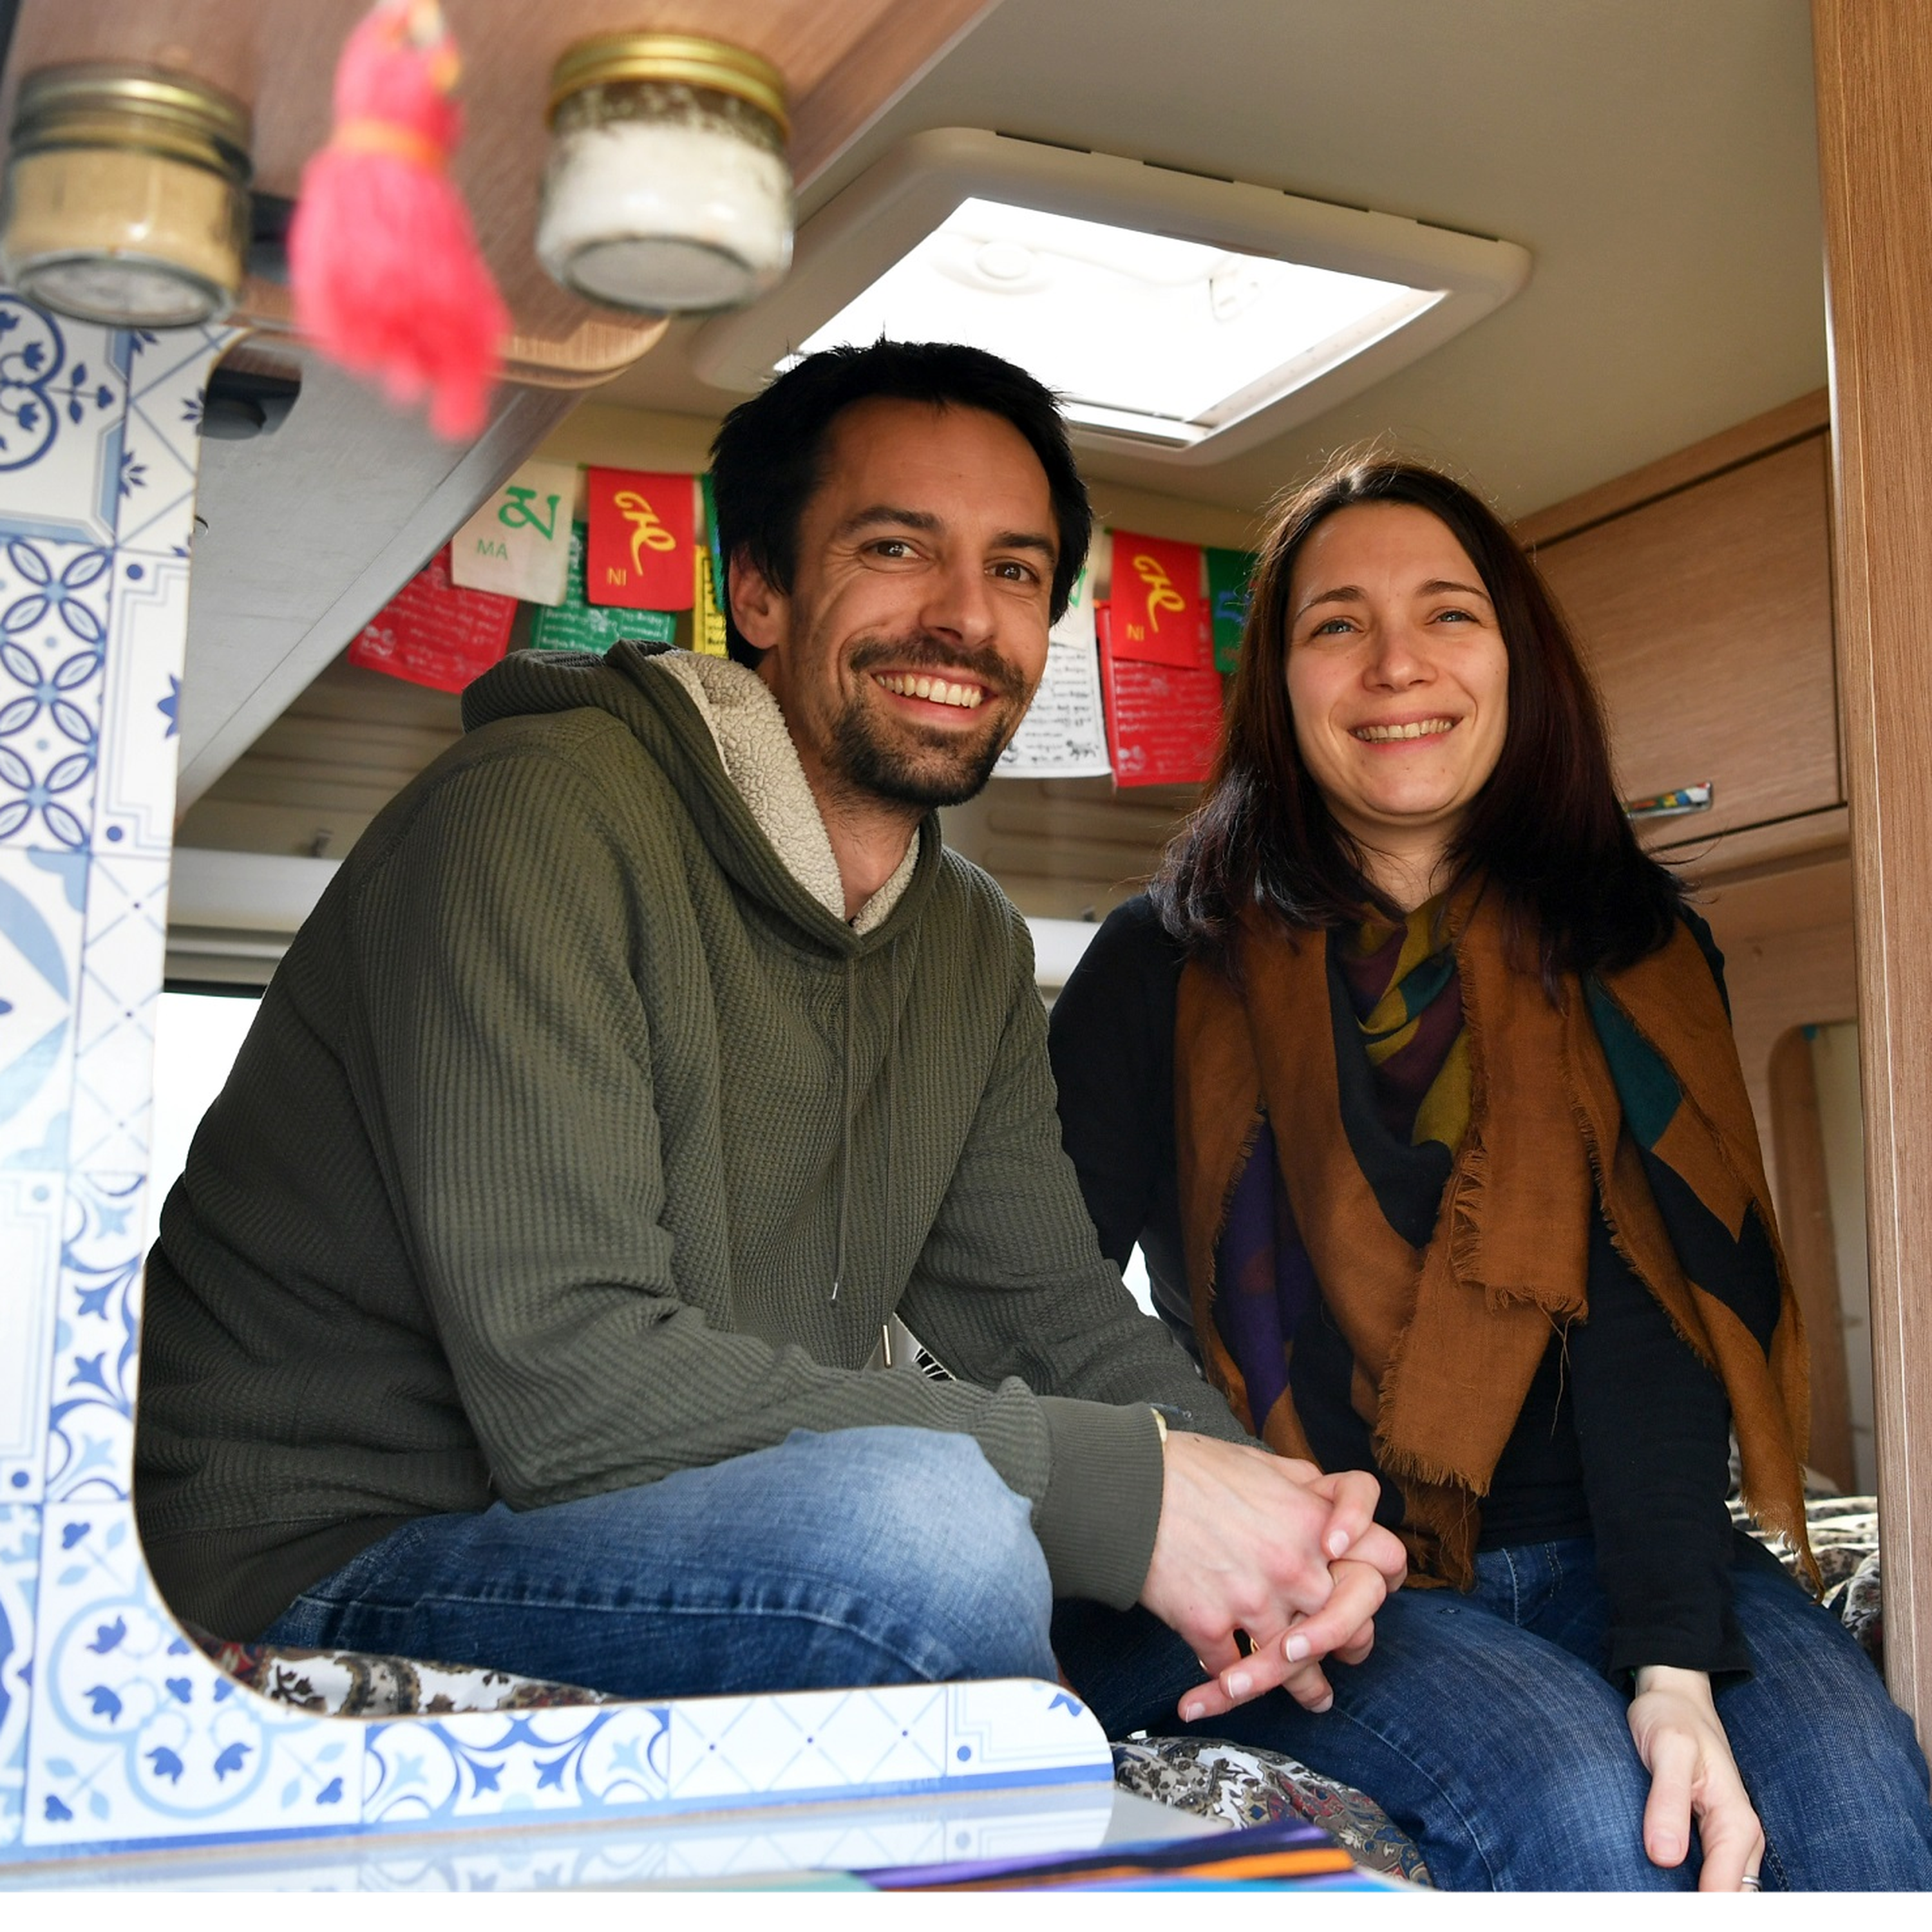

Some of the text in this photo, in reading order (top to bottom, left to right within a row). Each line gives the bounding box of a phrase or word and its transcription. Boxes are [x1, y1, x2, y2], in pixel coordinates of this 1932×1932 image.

[477, 538, 507, 561] MA
[607, 567, 627, 586] NI
[1127, 624, 1145, 642] NI
